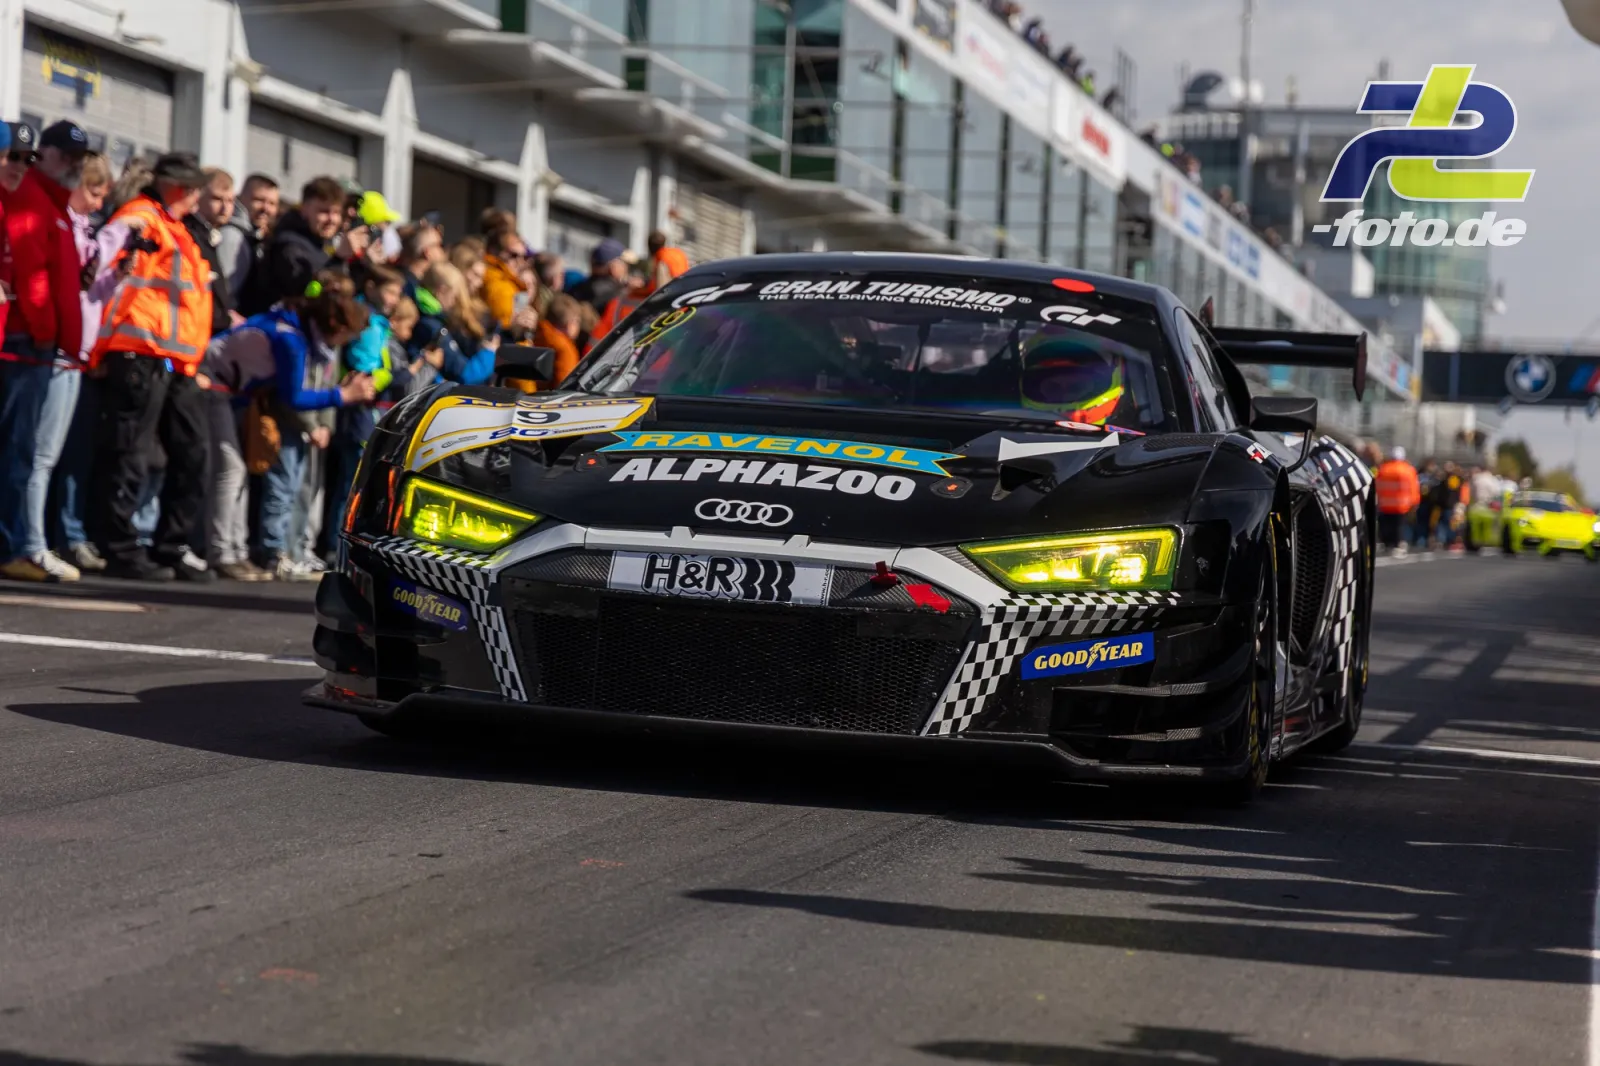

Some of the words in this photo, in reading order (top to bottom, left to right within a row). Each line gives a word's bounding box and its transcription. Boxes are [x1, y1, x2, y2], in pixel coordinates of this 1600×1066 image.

[759, 280, 861, 295] GRAN
[758, 293, 789, 301] THE
[838, 293, 906, 303] DRIVING
[908, 297, 1004, 313] SIMULATOR
[515, 410, 561, 425] 9
[630, 433, 920, 467] RAVENOL
[609, 458, 916, 501] ALPHAZOO
[642, 553, 740, 596] H&R
[1034, 641, 1144, 670] GOODYEAR
